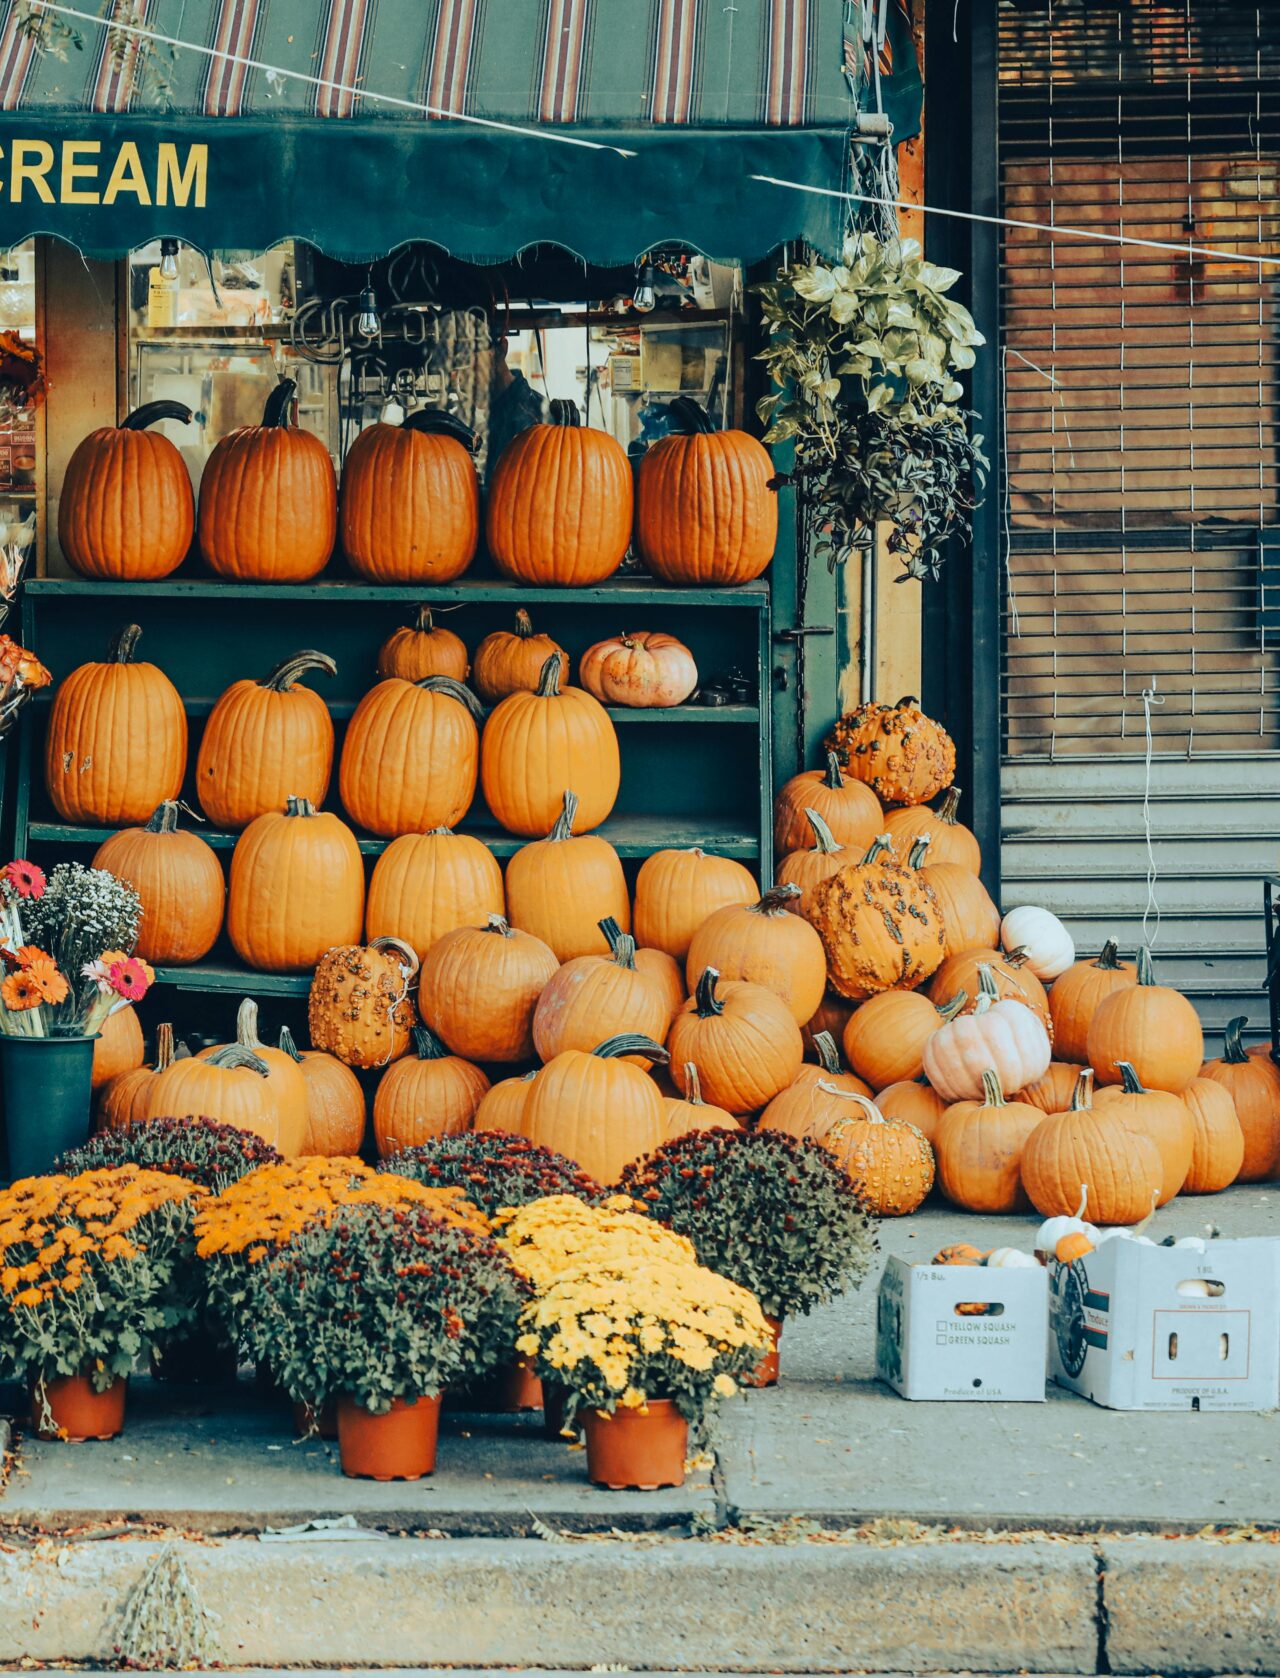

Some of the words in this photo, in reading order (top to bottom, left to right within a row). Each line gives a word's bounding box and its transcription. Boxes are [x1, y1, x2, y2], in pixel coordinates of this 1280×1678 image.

[949, 1322, 981, 1332] YELLOW
[983, 1322, 1016, 1332] SQUASH
[948, 1335, 975, 1345] GREEN
[977, 1335, 1010, 1345] SQUASH
